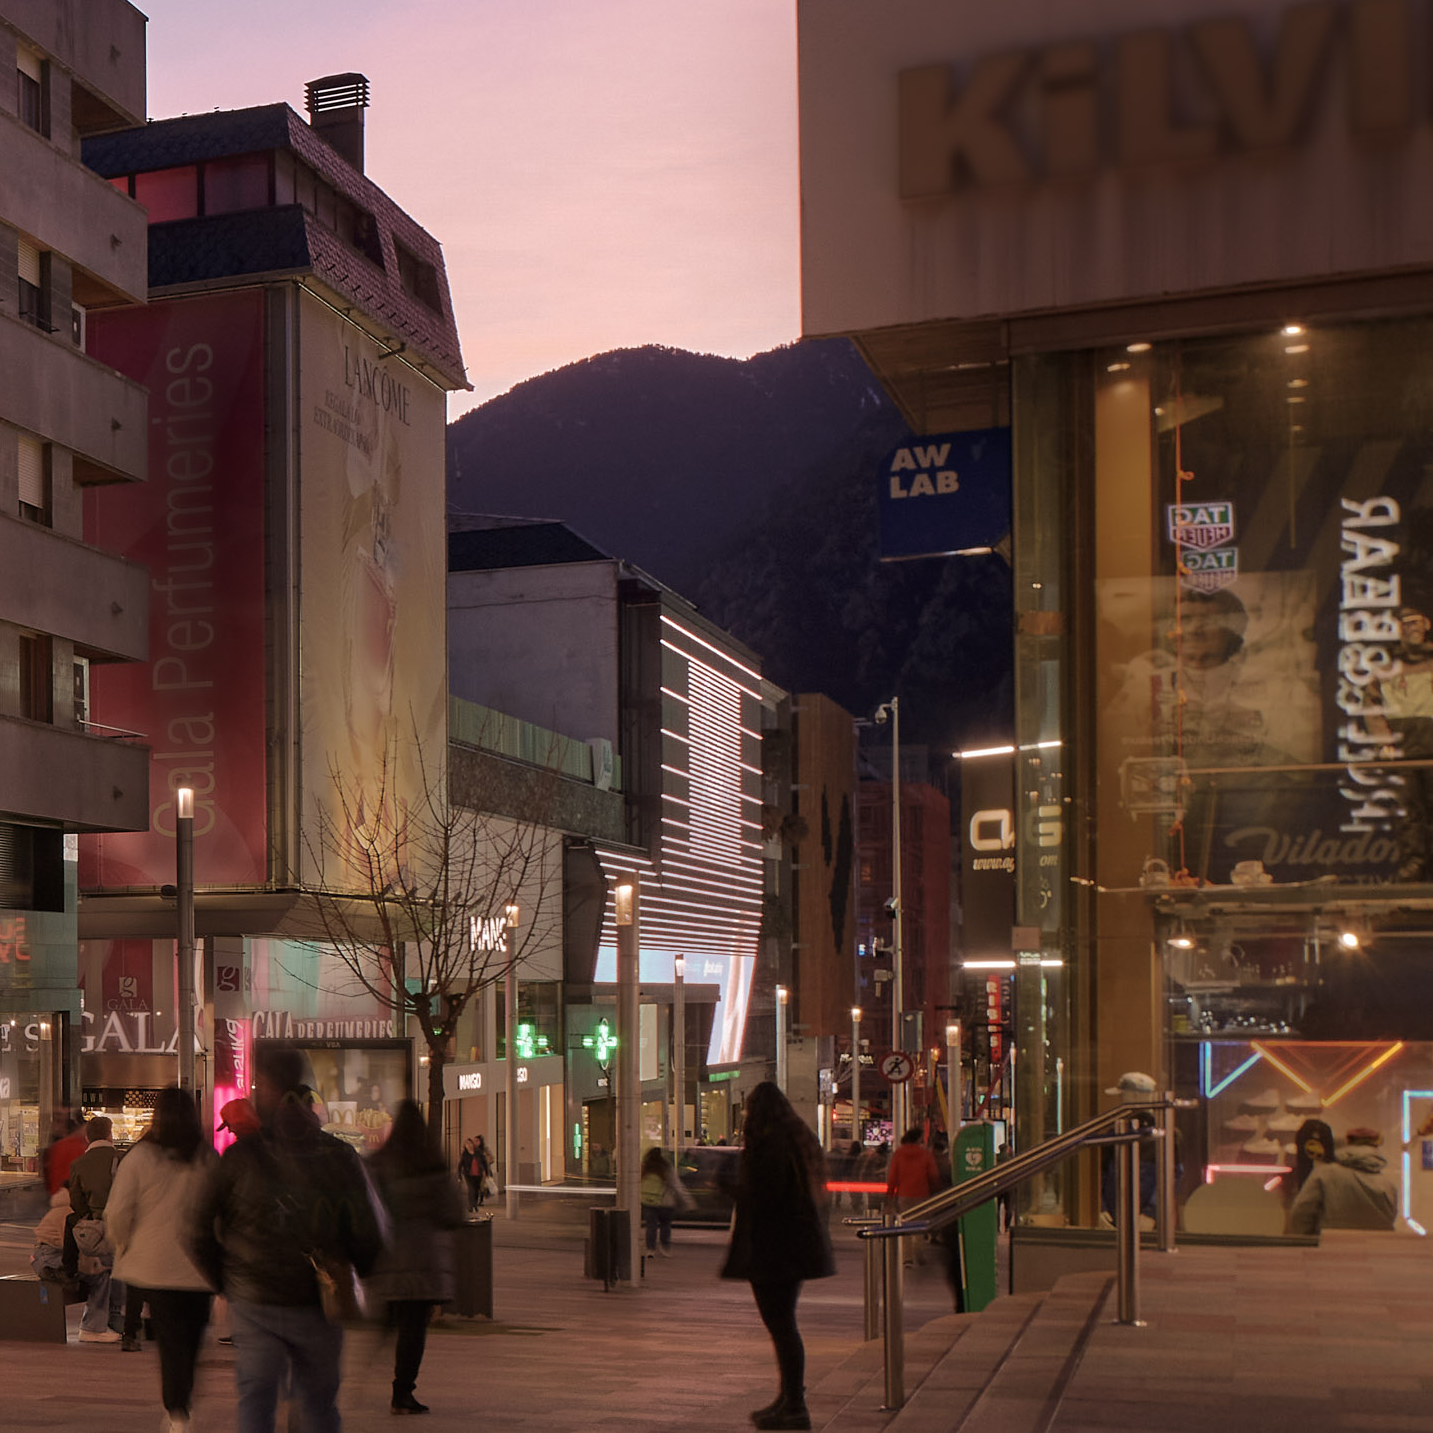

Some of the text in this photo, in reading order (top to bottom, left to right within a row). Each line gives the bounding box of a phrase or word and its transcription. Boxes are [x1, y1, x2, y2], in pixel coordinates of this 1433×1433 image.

[344, 344, 411, 427] LANCÔME
[890, 442, 952, 472] AW
[889, 470, 960, 499] LAB
[153, 342, 216, 840] Gala Perfumeries
[106, 998, 149, 1010] GALA
